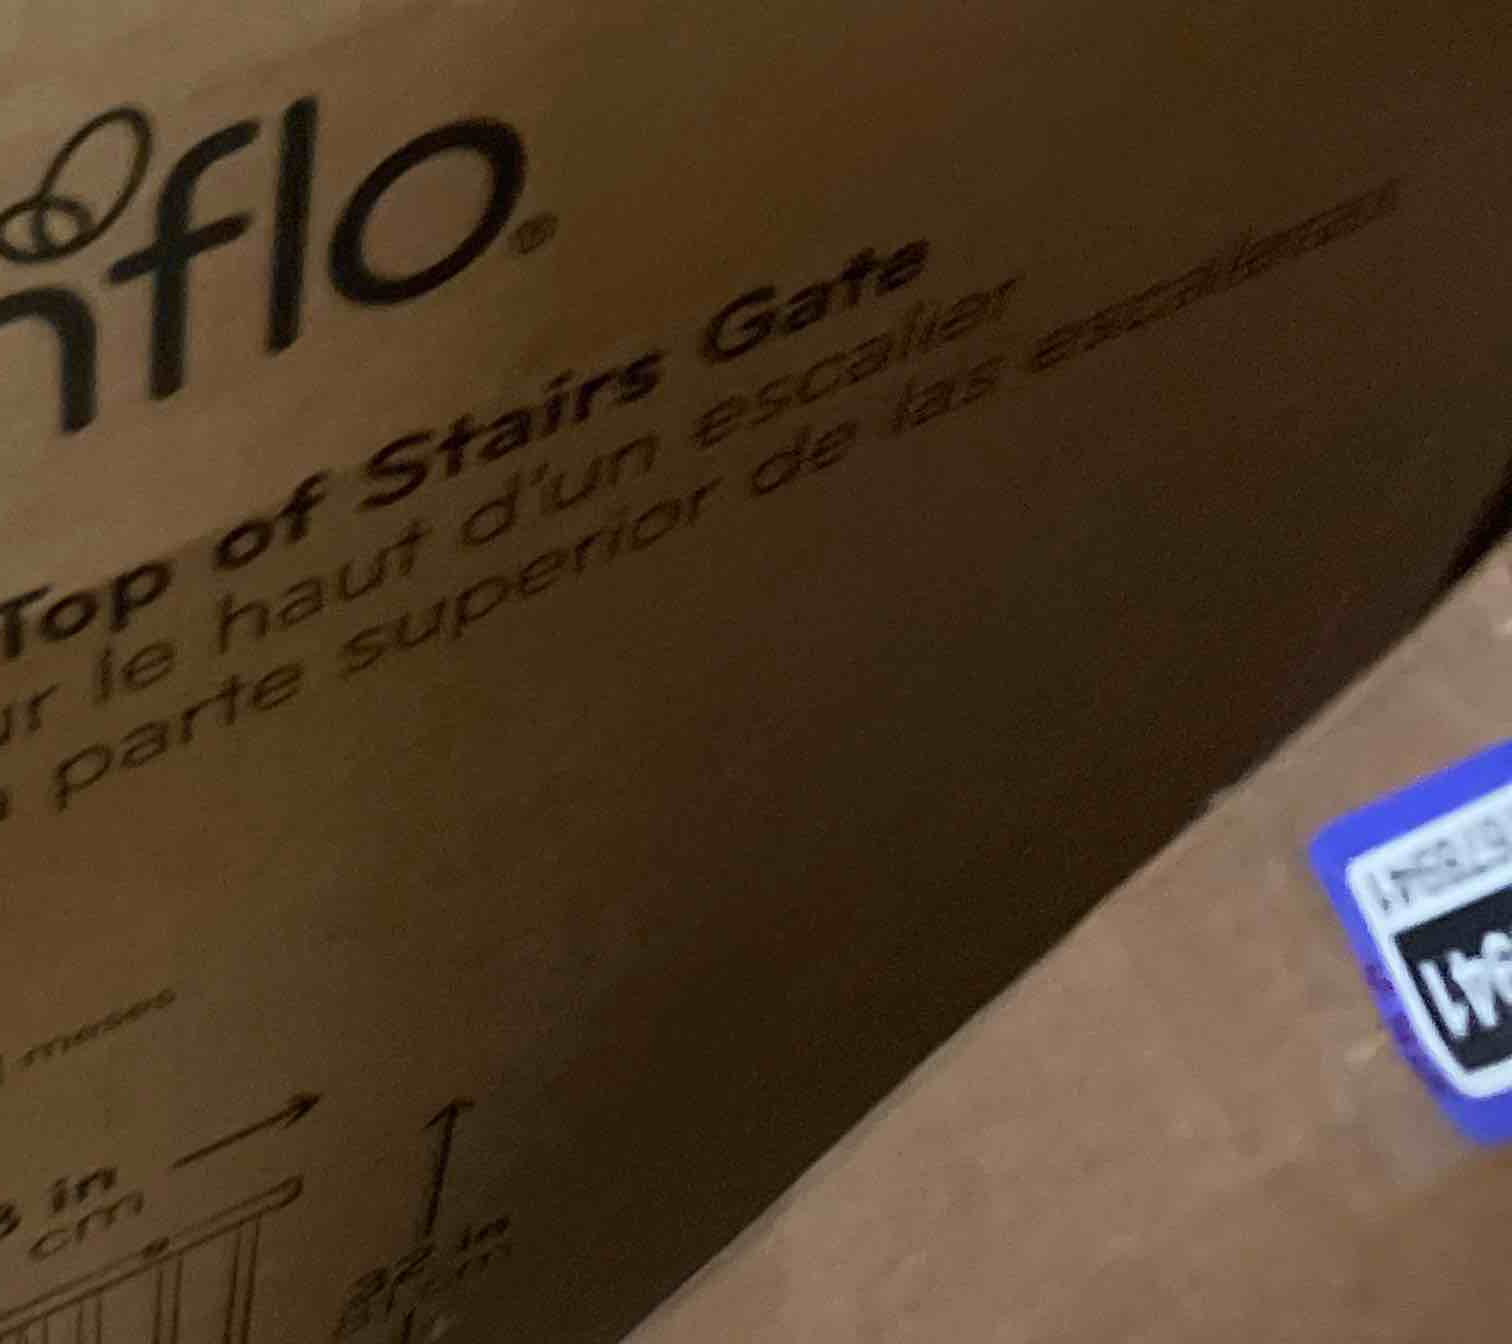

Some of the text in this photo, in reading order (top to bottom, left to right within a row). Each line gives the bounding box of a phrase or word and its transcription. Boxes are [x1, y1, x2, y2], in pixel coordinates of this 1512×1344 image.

[93, 636, 180, 707] le
[213, 518, 430, 657] haut
[459, 429, 665, 551] d'un
[690, 272, 1026, 456] escalier
[211, 465, 336, 573] of
[354, 346, 669, 513] Stairs
[698, 234, 934, 367] Gate
[51, 656, 306, 813] parte
[338, 471, 724, 682] superior
[749, 415, 861, 501] de
[888, 350, 1008, 442] las
[27, 1188, 146, 1260] cm
[46, 1165, 119, 1215] in
